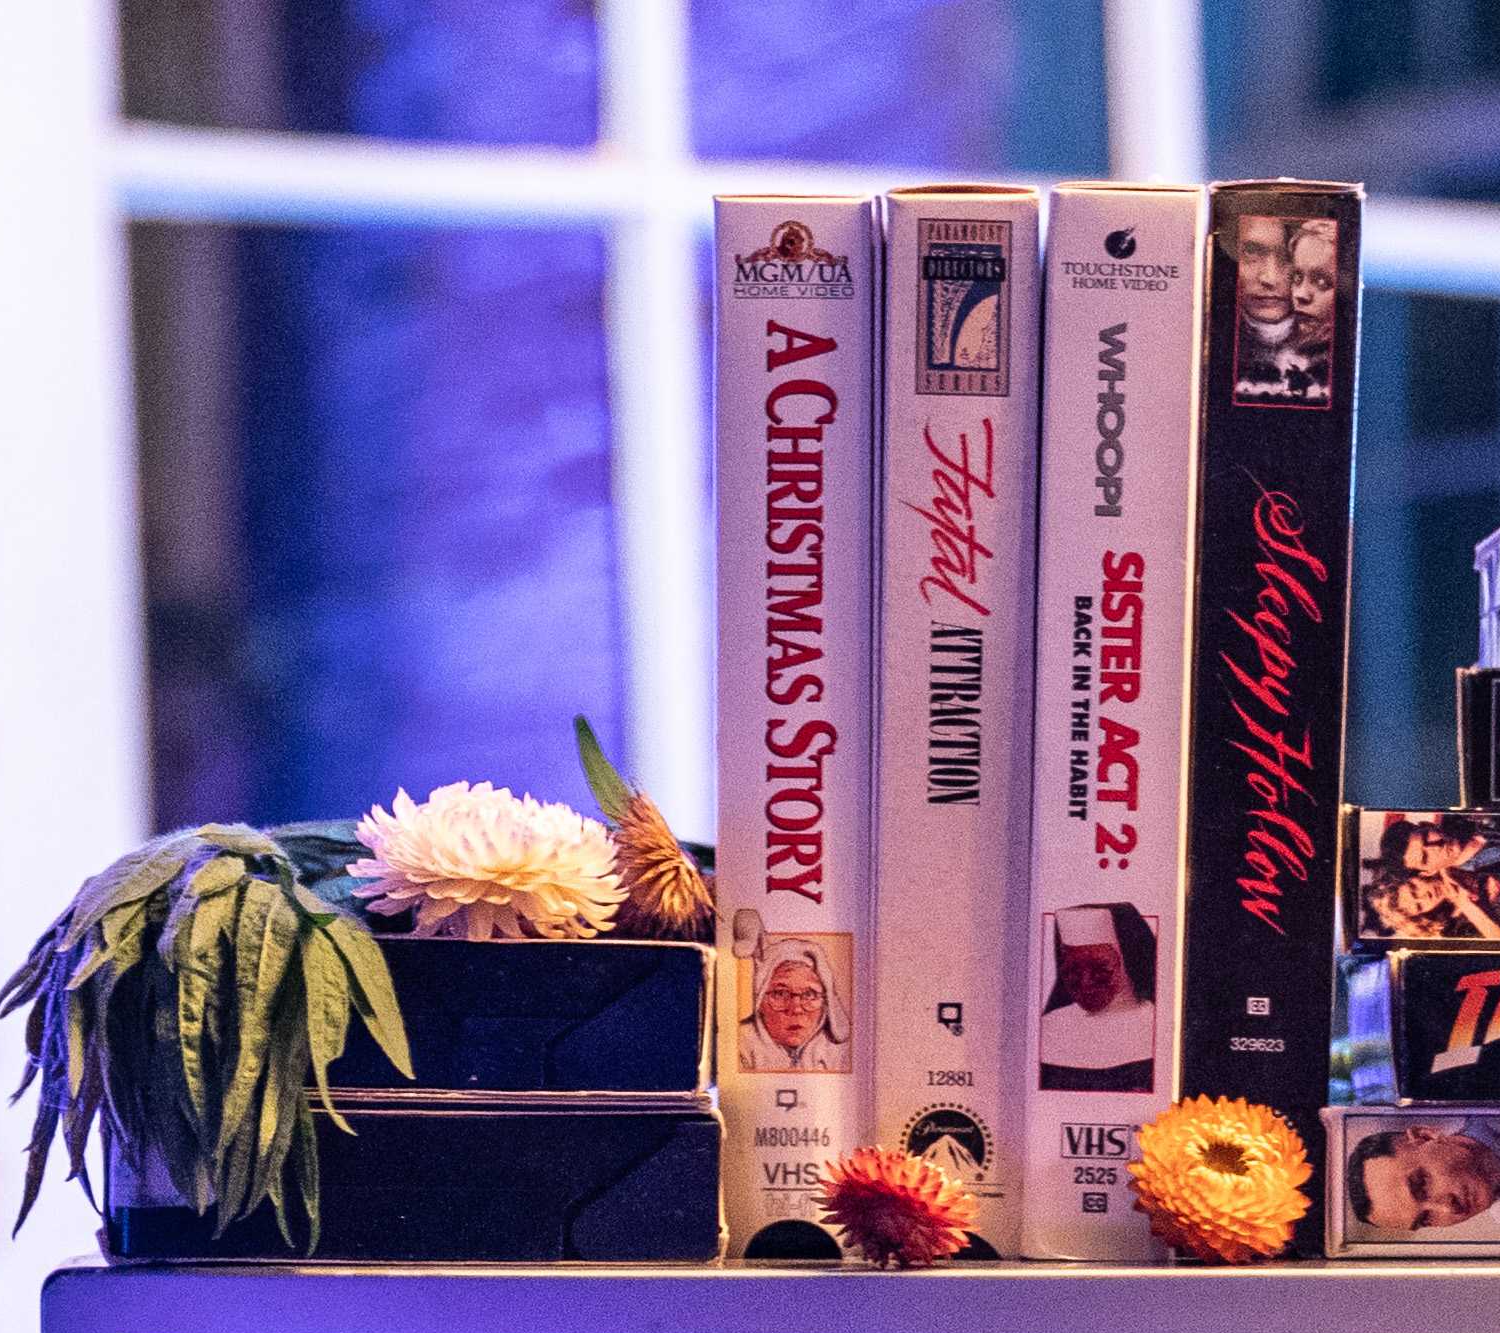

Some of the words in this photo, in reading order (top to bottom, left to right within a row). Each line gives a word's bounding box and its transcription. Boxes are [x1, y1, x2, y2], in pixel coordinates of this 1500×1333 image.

[733, 285, 792, 298] HOME
[798, 285, 855, 298] VIDEO
[734, 263, 854, 284] MGM/UA
[1061, 261, 1180, 280] TOUCHSTONE
[1071, 277, 1117, 291] HOME
[1122, 279, 1169, 293] VIDEO
[766, 319, 838, 372] A
[924, 372, 1001, 392] SERIES
[1094, 322, 1128, 518] WHOOPI
[903, 416, 995, 617] Fatal
[765, 379, 839, 706] CHRISTMAS
[1217, 463, 1329, 715] Sleepy
[1074, 595, 1094, 660] BACK
[1097, 551, 1145, 701] SISTER
[1073, 668, 1093, 691] IN
[927, 621, 983, 806] ATTRACTION
[1070, 699, 1091, 743] THE
[1097, 709, 1141, 811] ACT
[764, 718, 839, 904] STORY
[1068, 752, 1090, 821] HABIT
[1225, 690, 1318, 936] Hollow
[1094, 824, 1138, 871] 2:
[927, 1069, 975, 1088] 12881
[1064, 1124, 1130, 1158] VHS
[763, 1163, 821, 1185] VHS
[1073, 1166, 1118, 1185] 2525
